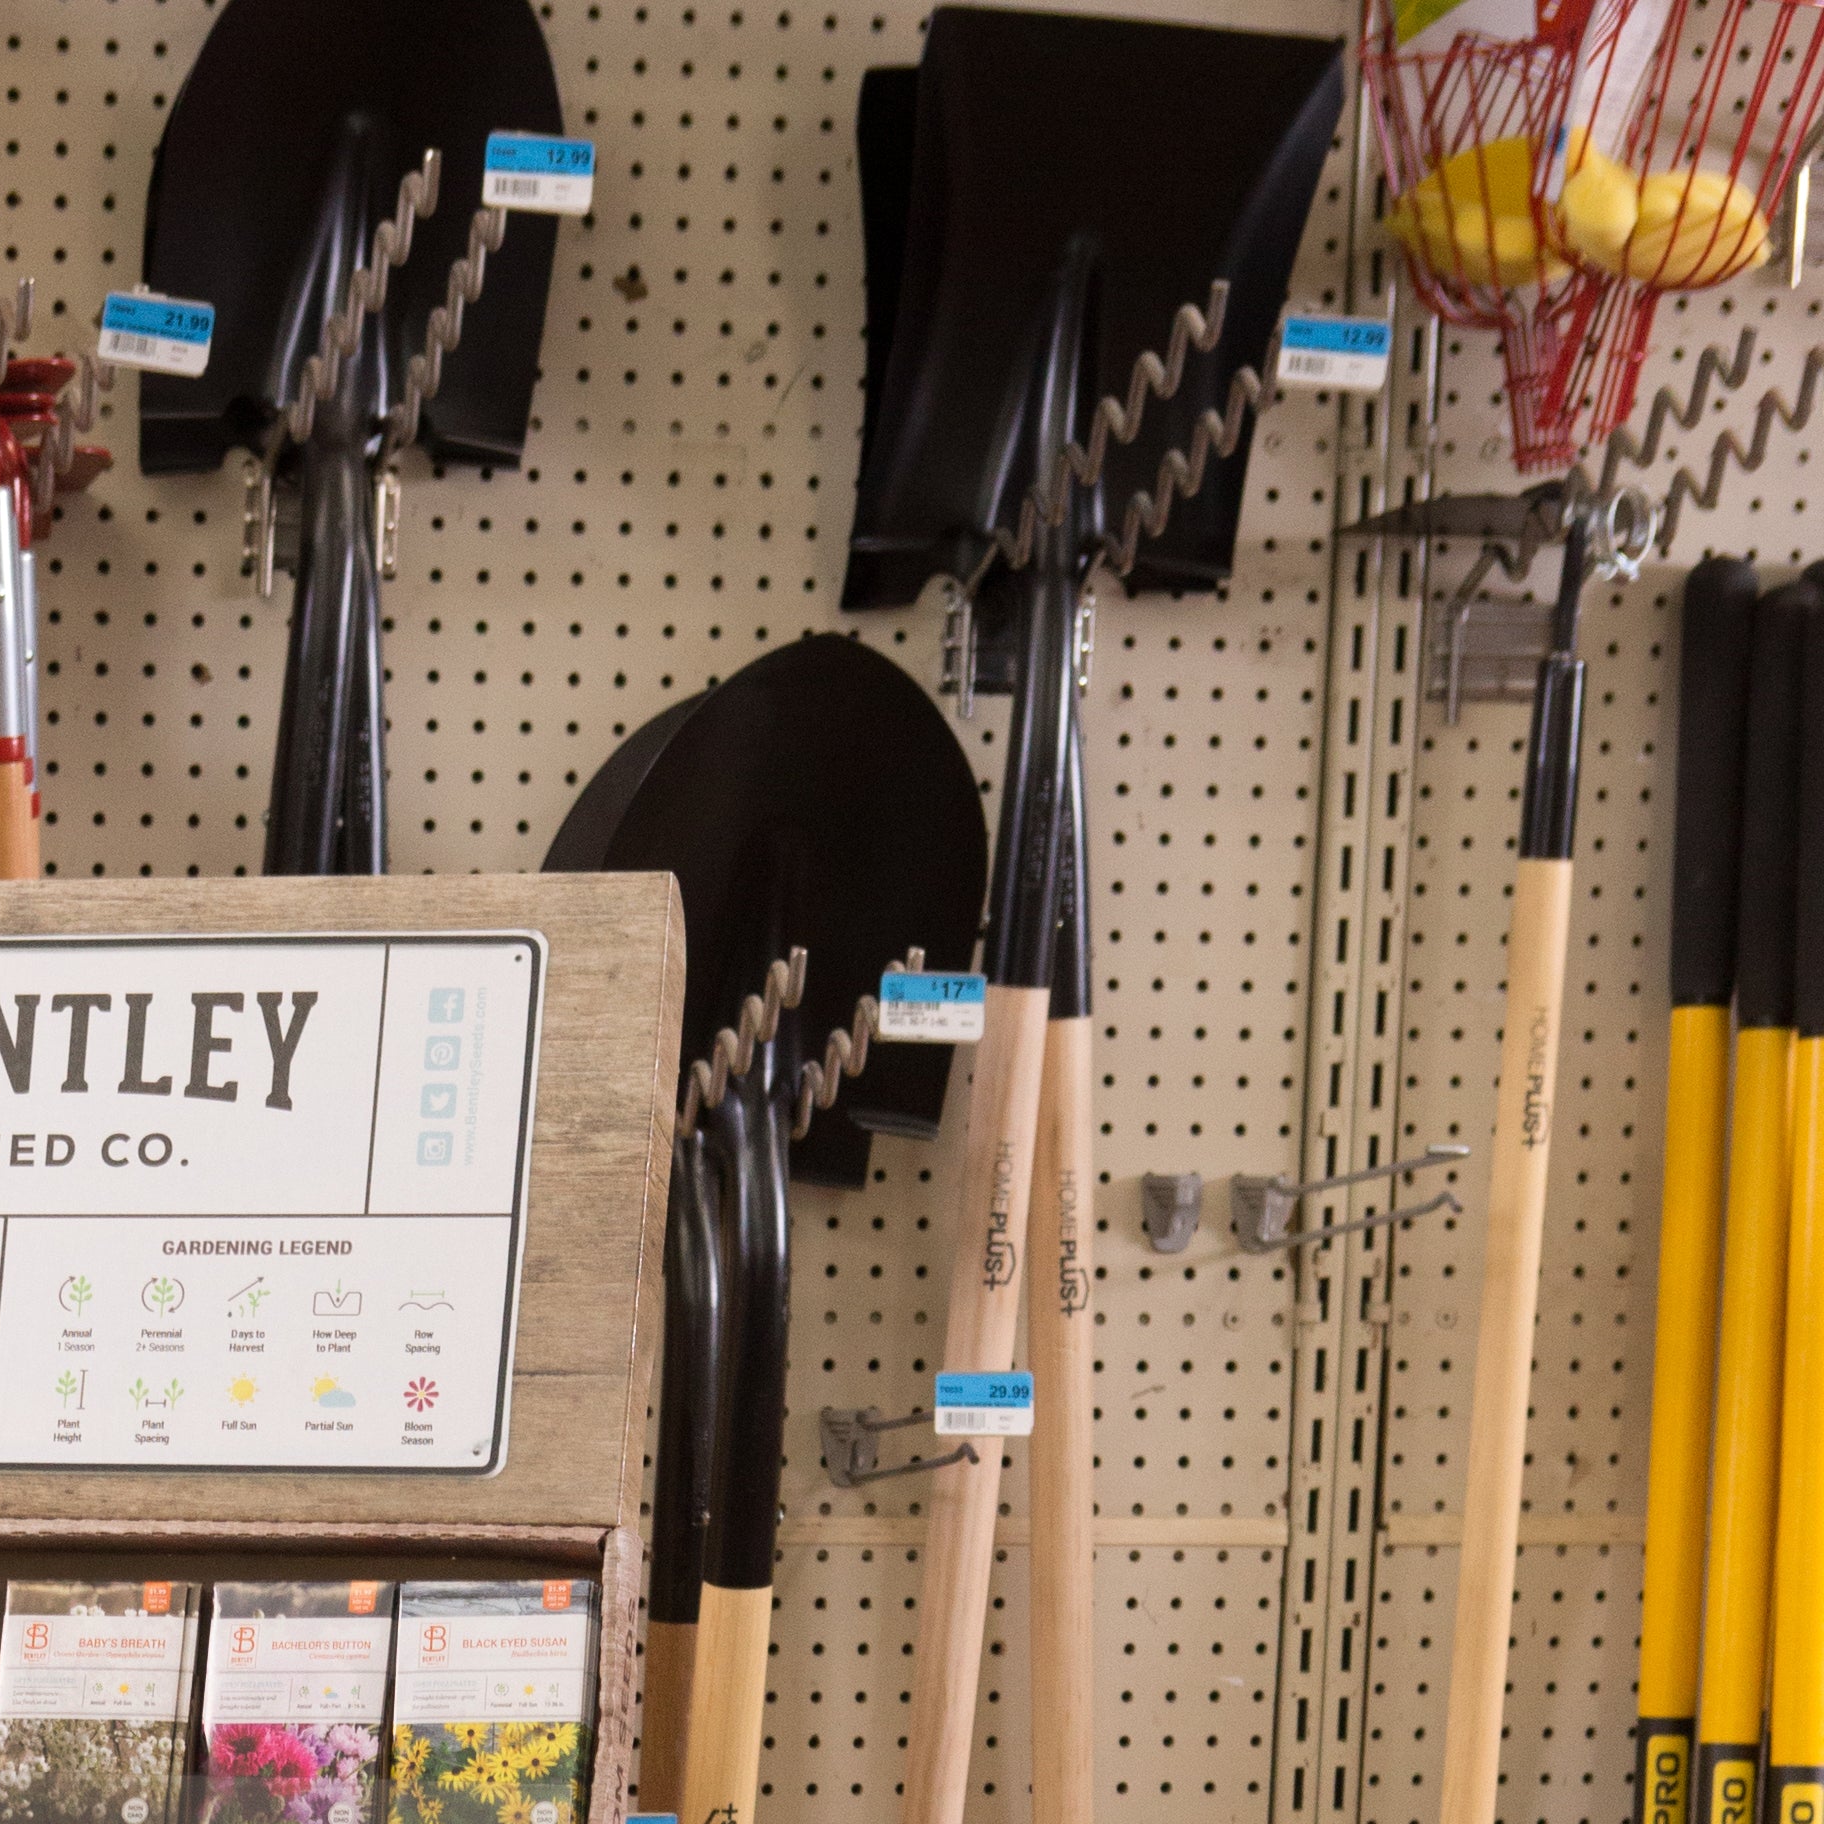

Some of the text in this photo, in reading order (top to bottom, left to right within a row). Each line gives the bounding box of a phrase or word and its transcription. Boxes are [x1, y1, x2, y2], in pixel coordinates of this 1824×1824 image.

[100, 1131, 189, 1168] CO.
[162, 1240, 353, 1256] GARDENING LEGEND
[61, 1328, 92, 1339] Annual
[141, 1328, 182, 1339] Perennial
[231, 1329, 252, 1341] Days
[312, 1329, 357, 1342] How Deep
[414, 1330, 434, 1340] Row
[63, 1342, 95, 1352] Season
[147, 1343, 185, 1353] Seasons
[229, 1343, 264, 1353] Harvest
[327, 1344, 351, 1353] Plant
[405, 1343, 441, 1355] Spacing
[989, 1384, 1029, 1399] 29.99
[57, 1419, 80, 1429] Plant
[141, 1420, 165, 1430] Plant
[221, 1421, 257, 1431] Full Sun
[305, 1421, 354, 1431] Partial Sun
[404, 1422, 433, 1432] Bloom
[53, 1433, 82, 1445] Height
[134, 1433, 170, 1446] Spacing
[401, 1436, 434, 1446] Season
[79, 1638, 166, 1648] BABY'S BREATH
[272, 1640, 371, 1650] BACHELOR'S BUTTON
[462, 1637, 568, 1648] BLACK EYED SUSAN
[615, 1596, 637, 1745] SEEDS
